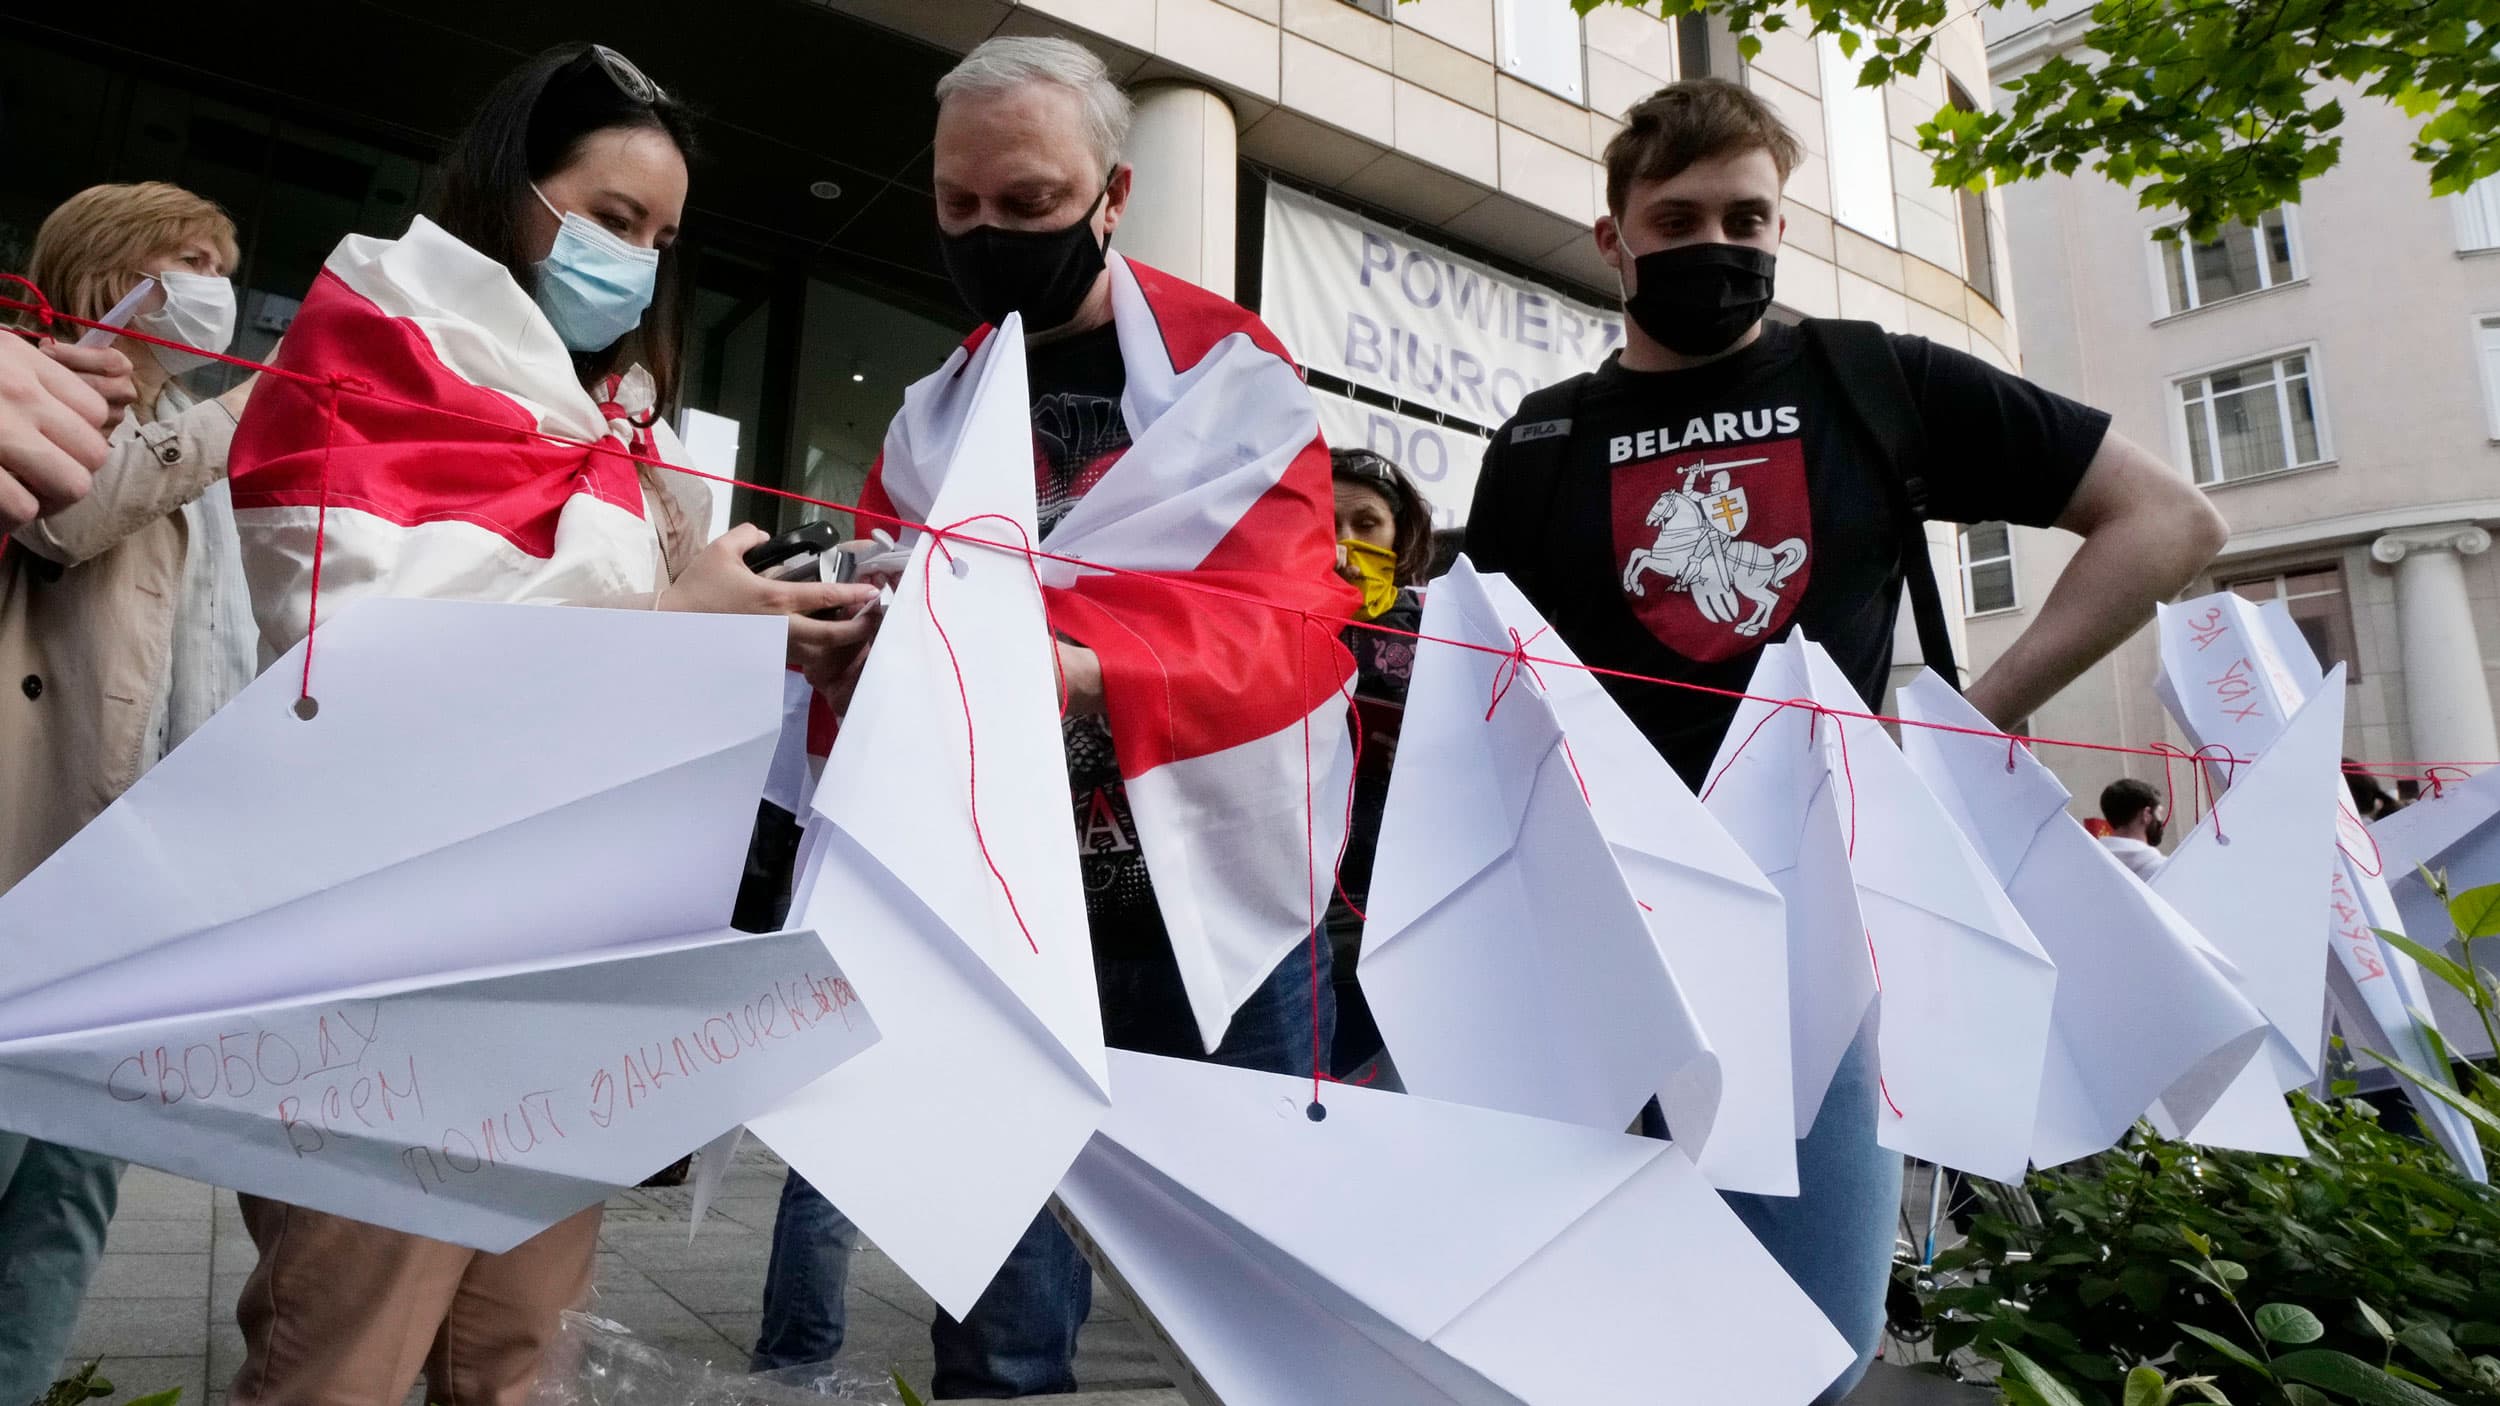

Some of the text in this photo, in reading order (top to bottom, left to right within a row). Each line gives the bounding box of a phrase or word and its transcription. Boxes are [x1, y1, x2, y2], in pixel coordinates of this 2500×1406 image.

[1345, 311, 1541, 421] BIURO
[1366, 412, 1449, 483] DO
[1522, 423, 1557, 440] FILA
[1609, 405, 1801, 464] BELARUS
